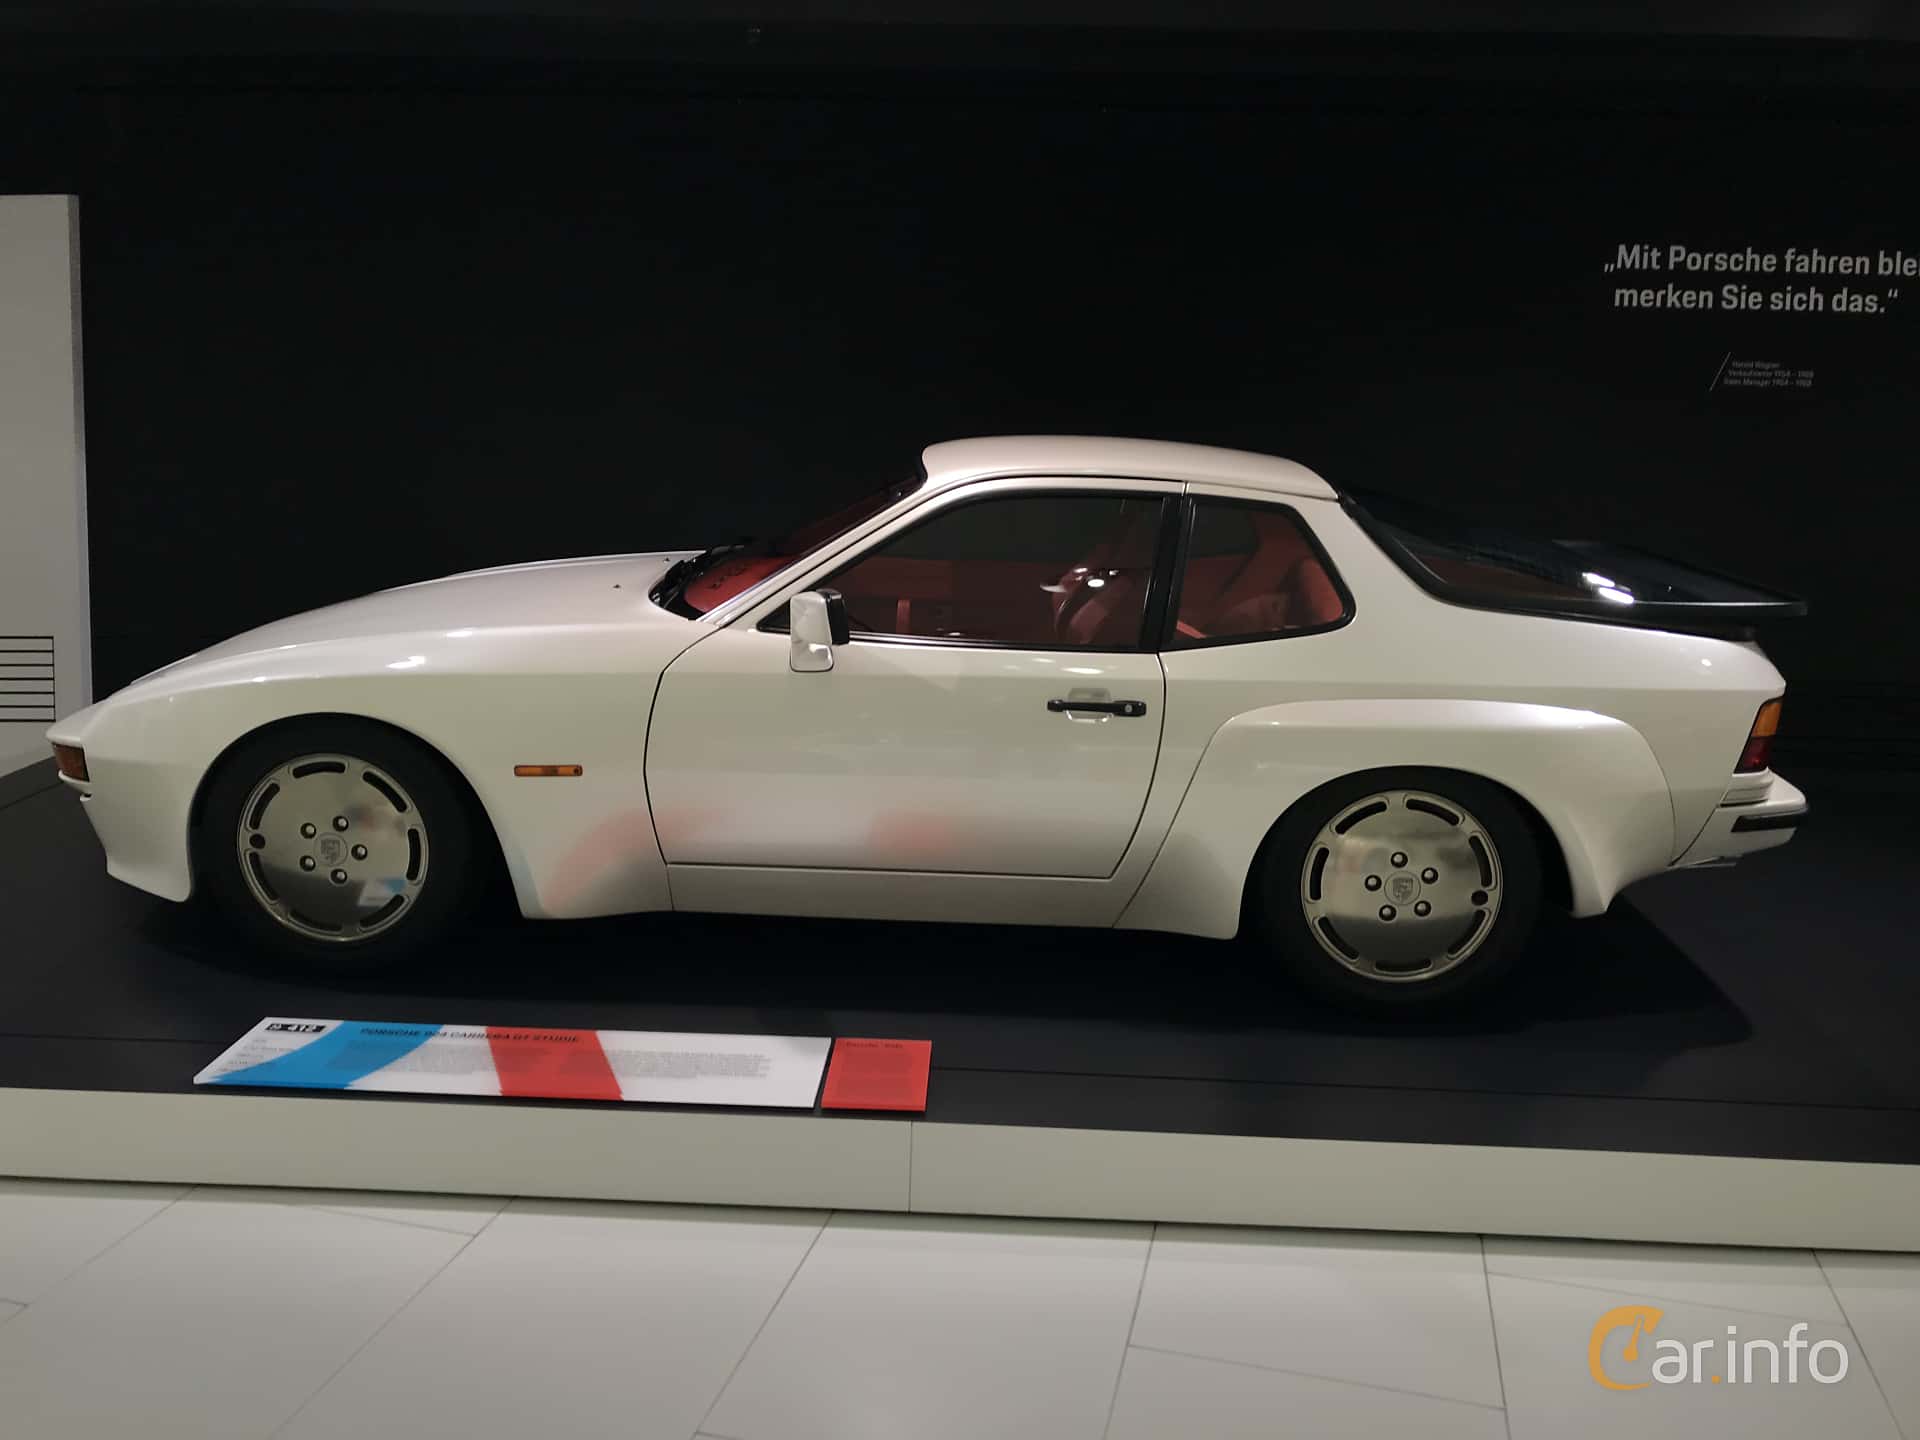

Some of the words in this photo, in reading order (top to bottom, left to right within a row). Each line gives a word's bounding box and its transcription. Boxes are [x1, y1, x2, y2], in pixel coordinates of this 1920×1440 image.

[1668, 245, 1777, 273] Porsche
[1785, 248, 1870, 275] fahren
[1614, 284, 1714, 309] merken
[1721, 285, 1763, 310] Sie
[1770, 286, 1824, 312] sich
